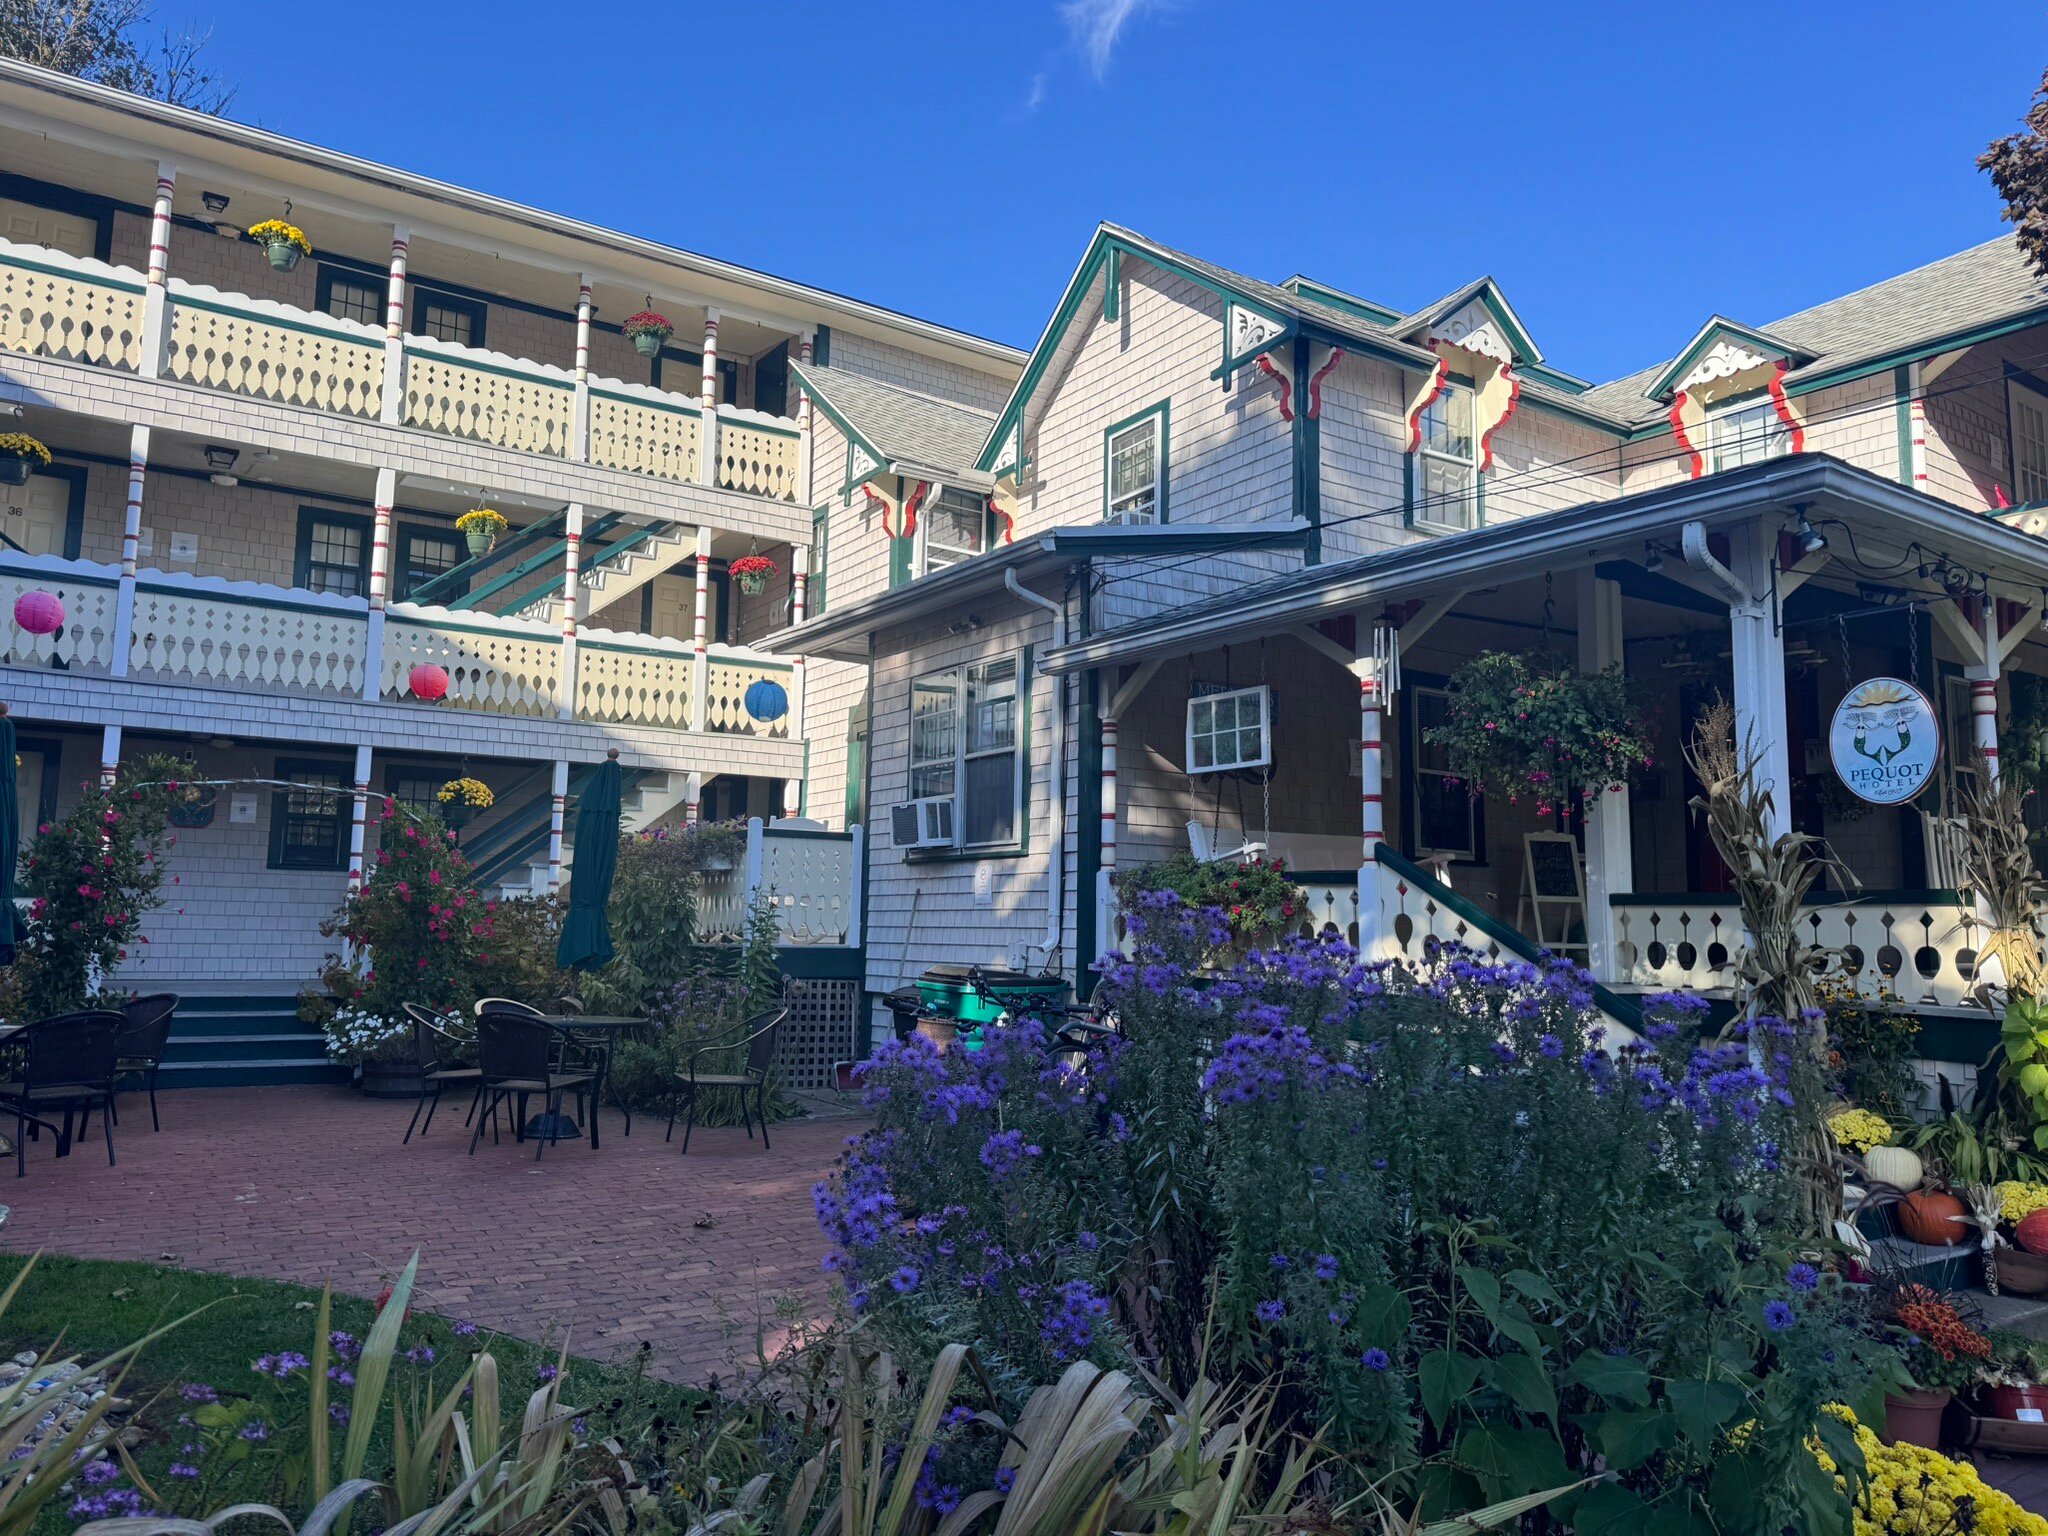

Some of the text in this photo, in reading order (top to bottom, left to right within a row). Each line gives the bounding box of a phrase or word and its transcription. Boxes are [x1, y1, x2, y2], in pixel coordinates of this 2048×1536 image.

[8, 506, 22, 516] 36
[678, 603, 688, 611] 37
[1850, 763, 1923, 782] PEQUOT
[1860, 778, 1915, 789] HOTEL
